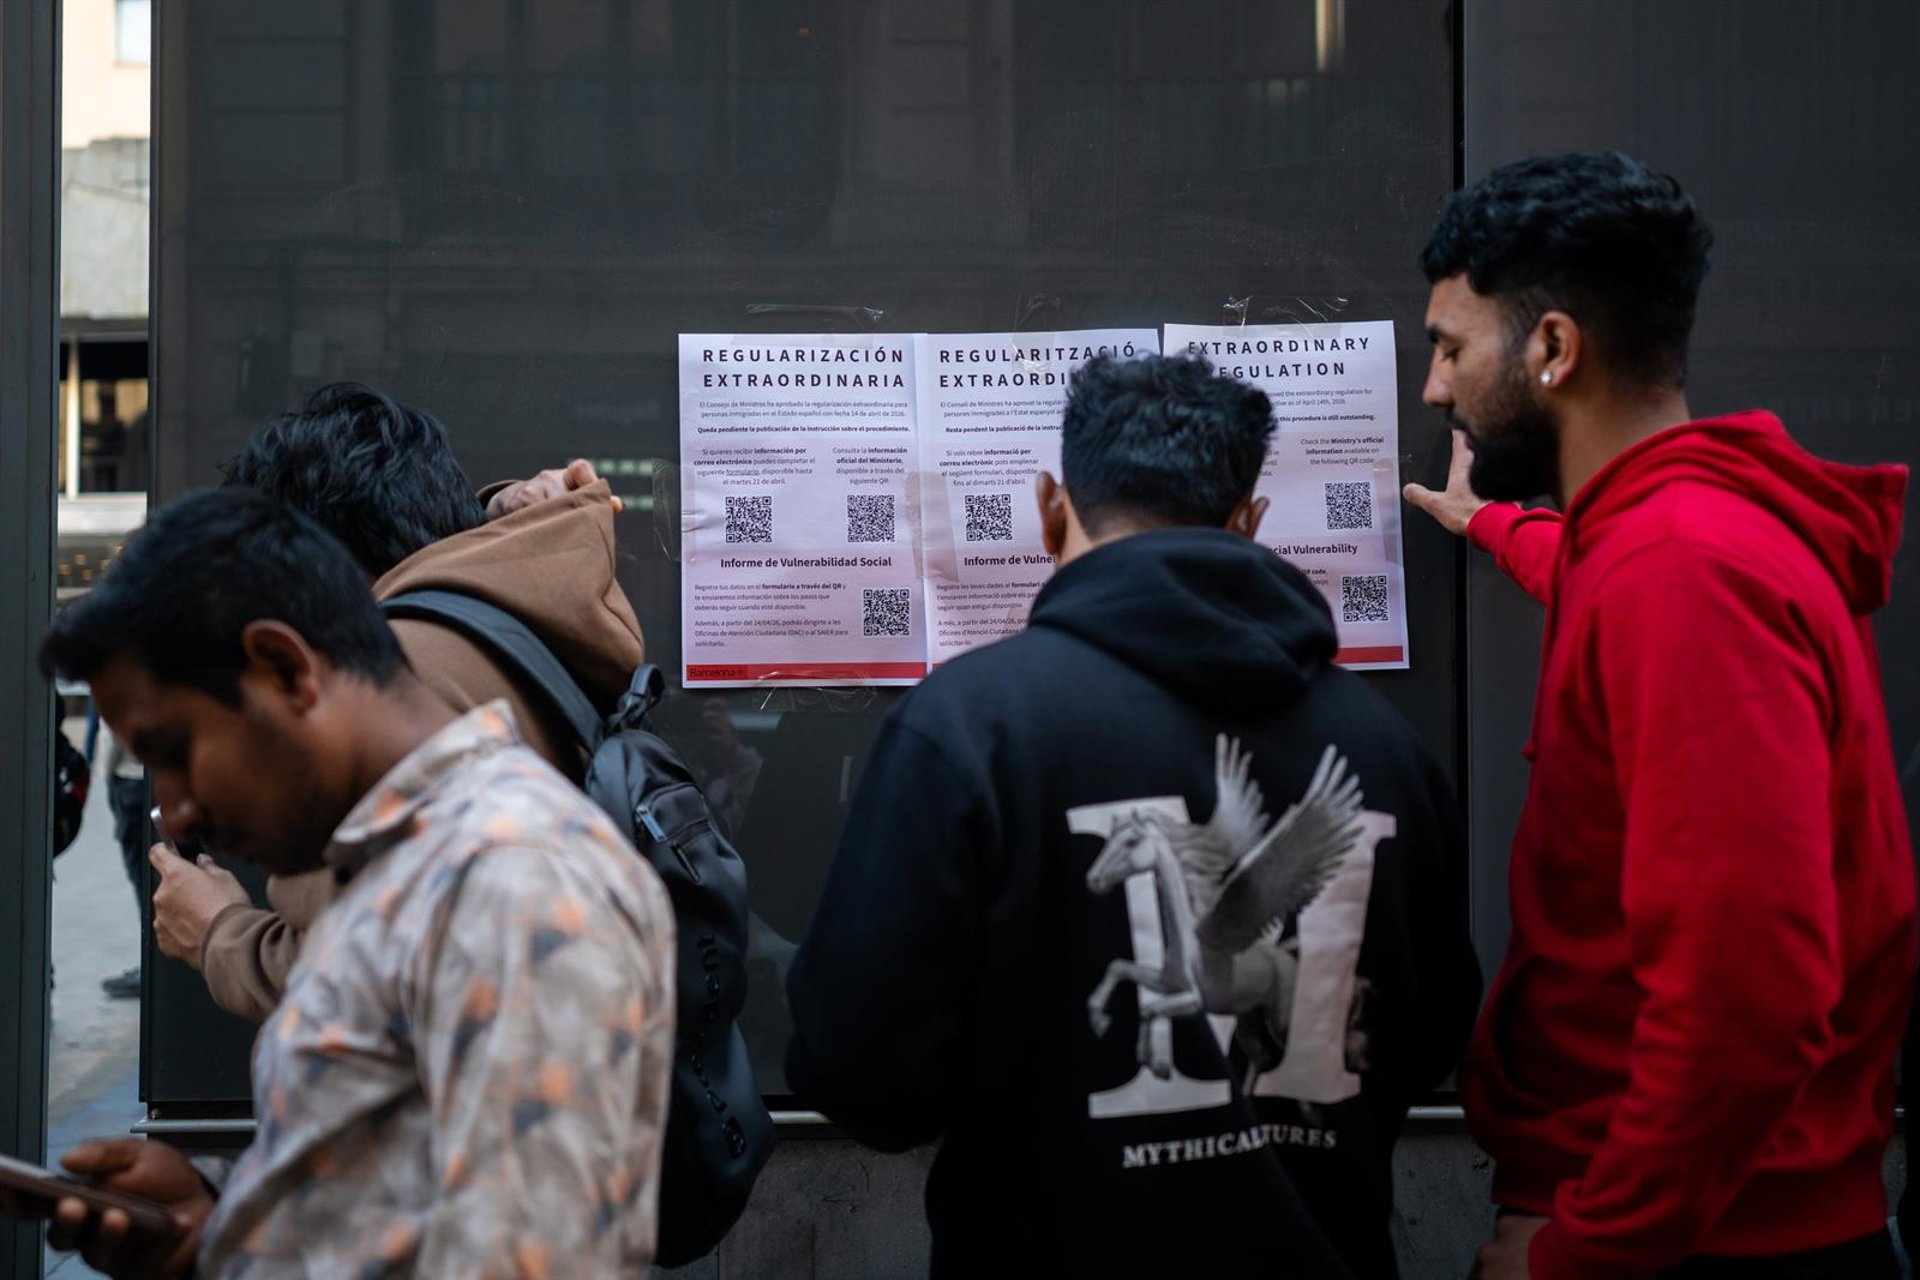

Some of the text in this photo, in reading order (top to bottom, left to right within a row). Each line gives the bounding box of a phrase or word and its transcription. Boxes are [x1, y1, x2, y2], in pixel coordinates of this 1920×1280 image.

[1188, 338, 1369, 355] EXTRAORDINARY
[703, 346, 903, 363] REGULARIZACIÓN
[940, 342, 1134, 363] REGULARITZACIÓ
[1219, 362, 1345, 379] EGULATION
[703, 374, 904, 388] EXTRAORDINARIA
[940, 372, 1066, 388] EXTRAORDI
[706, 401, 730, 409] Consejo
[775, 401, 804, 409] aprobado
[811, 401, 852, 409] regularización
[1291, 415, 1321, 423] procedure
[697, 426, 718, 434] Queda
[718, 426, 749, 434] pendiente
[756, 425, 791, 433] publicación
[865, 425, 911, 433] procedimiento.
[963, 426, 988, 434] pendent
[995, 425, 1026, 433] publicació
[1362, 436, 1384, 444] official
[709, 448, 733, 457] quieres
[754, 447, 794, 455] información
[984, 448, 1019, 456] informació
[1306, 447, 1343, 455] information
[753, 458, 776, 466] puedes
[777, 457, 809, 466] completar
[961, 458, 994, 466] electrònic
[994, 459, 1009, 467] pots
[1009, 458, 1039, 466] emplenar
[836, 467, 869, 476] disponible
[1273, 543, 1358, 557] cial Vulnerability
[720, 556, 892, 568] Informe de Vulnerabilidad Social
[964, 555, 1007, 566] Informe
[1008, 554, 1022, 565] de
[694, 584, 719, 592] Registra
[690, 667, 736, 677] Barcelona
